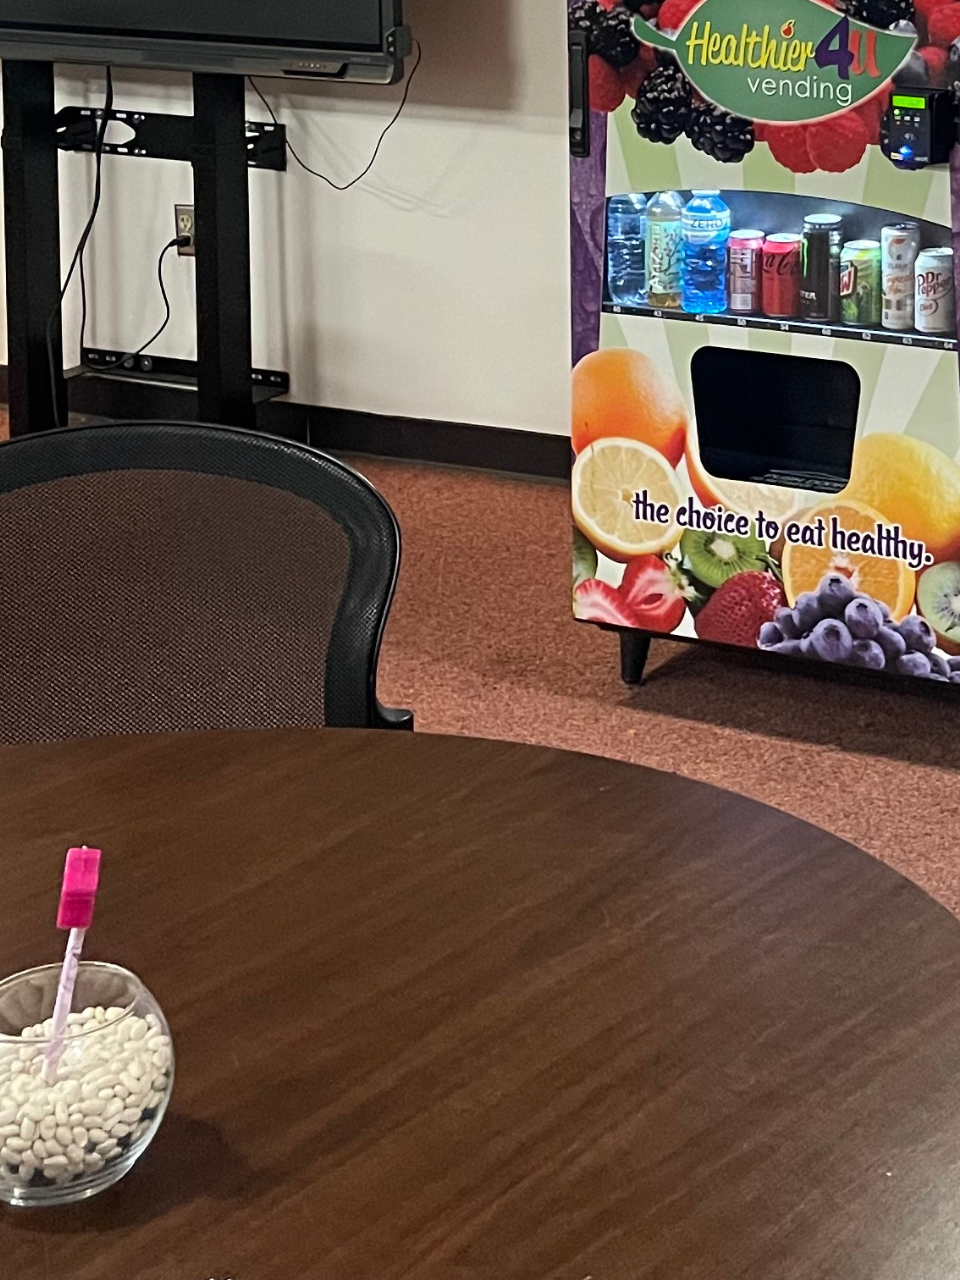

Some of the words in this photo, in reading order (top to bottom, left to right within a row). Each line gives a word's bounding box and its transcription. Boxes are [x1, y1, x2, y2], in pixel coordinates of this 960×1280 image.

[746, 74, 852, 107] vending
[690, 218, 724, 229] ZERO
[916, 274, 952, 297] Pepper
[925, 271, 943, 284] Dr
[632, 489, 670, 524] the
[675, 496, 750, 536] choice
[755, 510, 780, 540] to
[786, 517, 827, 547] eat
[831, 516, 934, 568] healthy.
